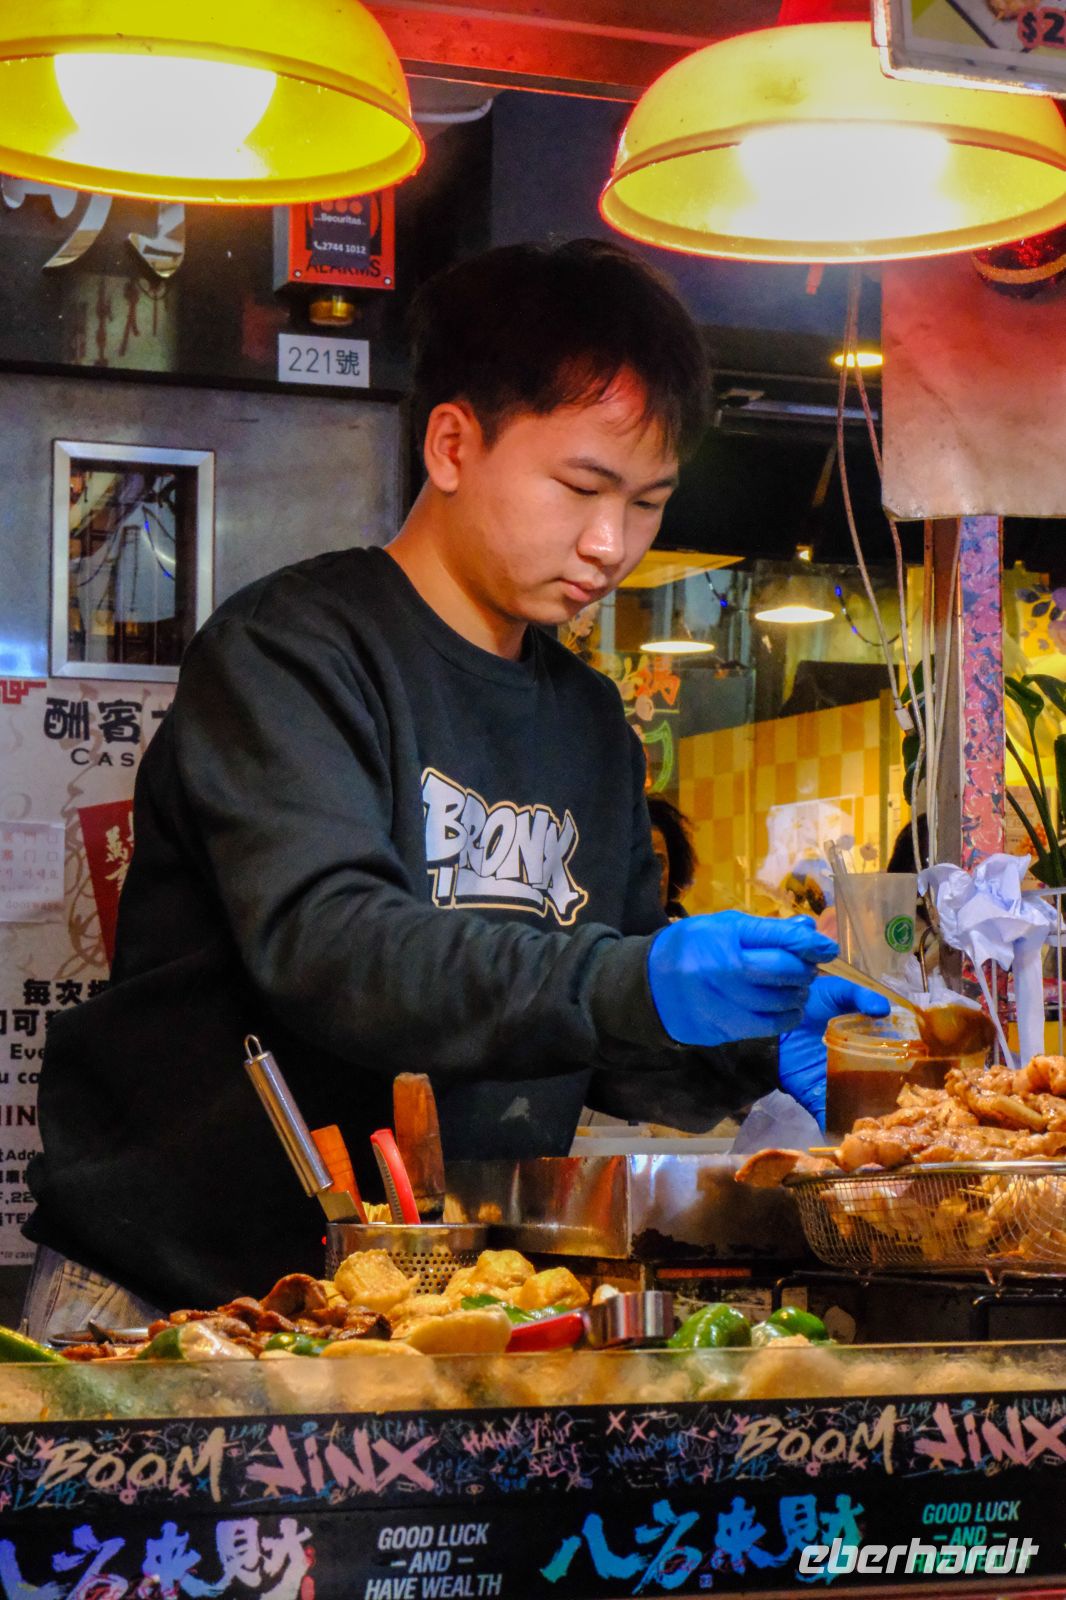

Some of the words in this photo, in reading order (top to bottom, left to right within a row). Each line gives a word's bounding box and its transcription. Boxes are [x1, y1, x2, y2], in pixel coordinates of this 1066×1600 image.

[288, 346, 360, 376] 221號
[734, 1404, 898, 1475] BOOM
[36, 1427, 226, 1502] BOOM
[922, 1503, 972, 1525] GOOD
[974, 1500, 1021, 1522] LUCK
[377, 1526, 434, 1551] GOOD
[437, 1522, 490, 1547] LUCK
[949, 1526, 988, 1547] AND
[408, 1550, 451, 1574] AND
[364, 1576, 418, 1600] HAVE
[421, 1573, 502, 1599] WEALTH
